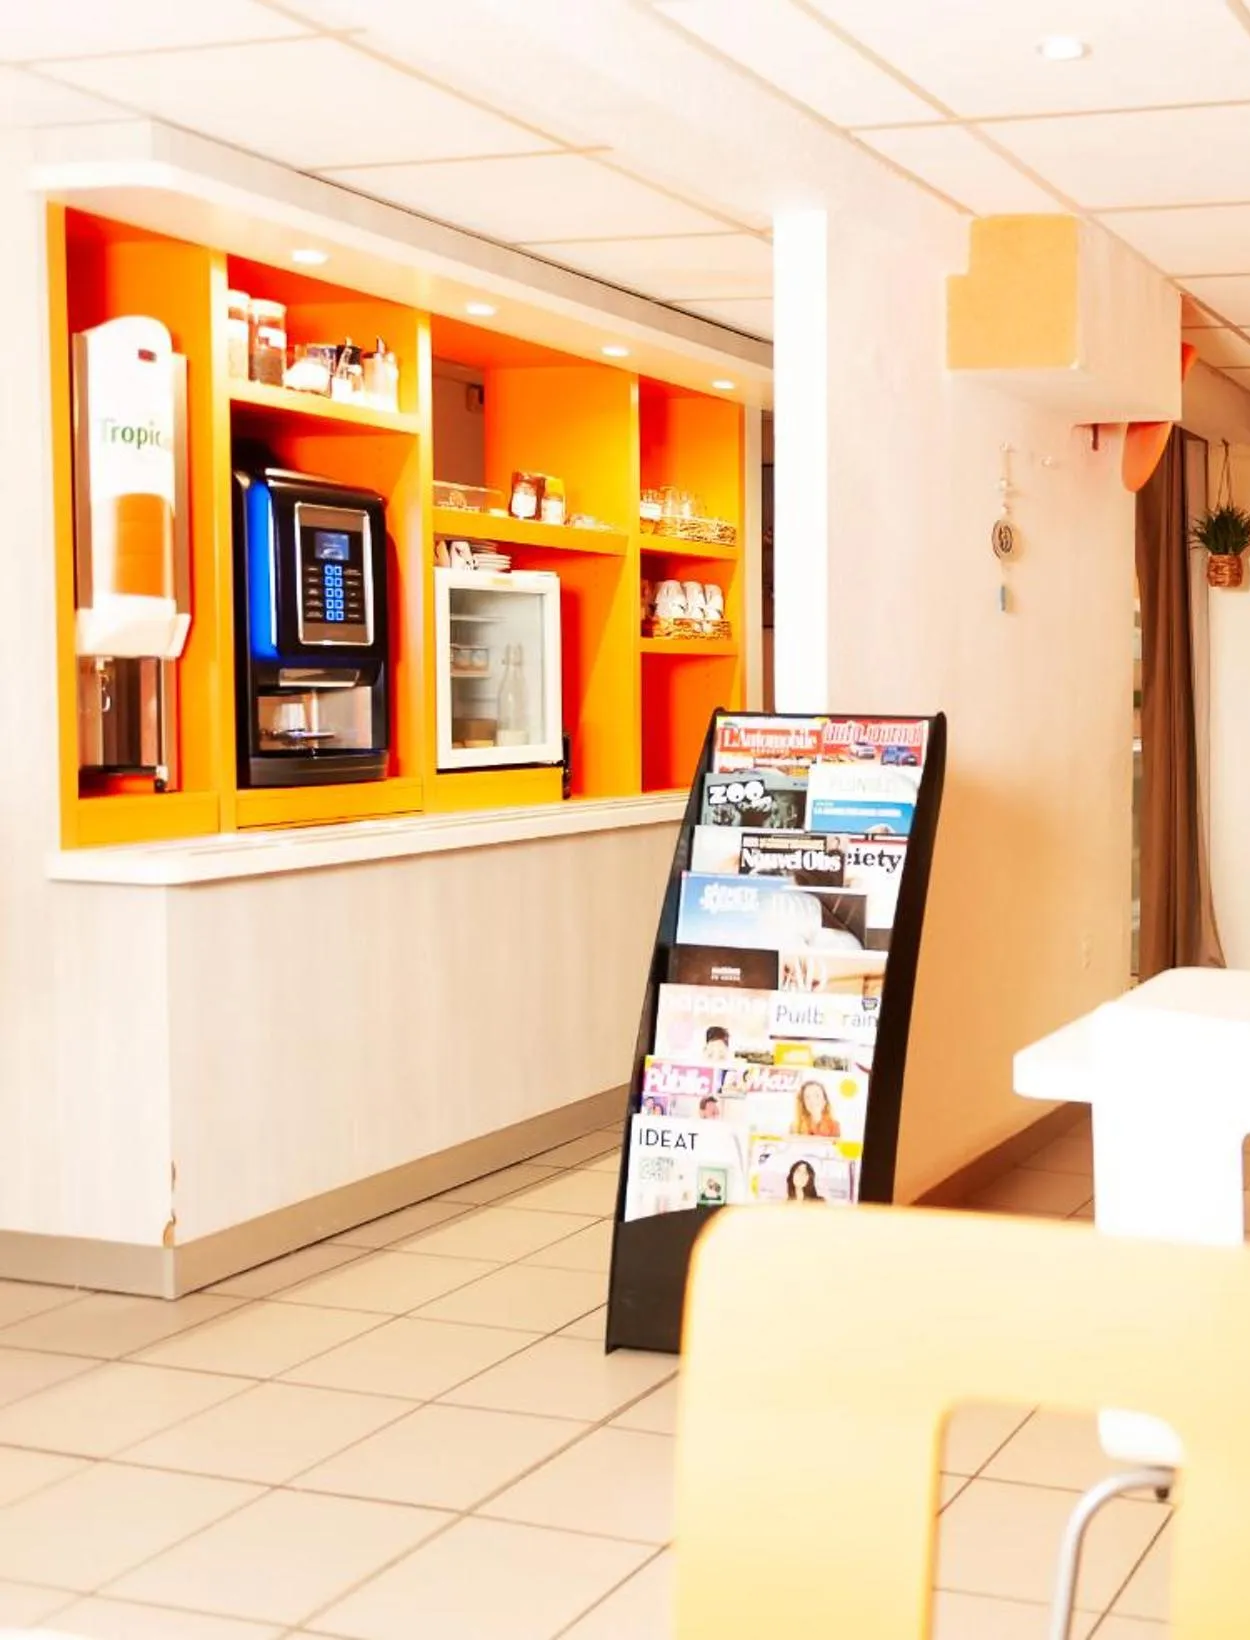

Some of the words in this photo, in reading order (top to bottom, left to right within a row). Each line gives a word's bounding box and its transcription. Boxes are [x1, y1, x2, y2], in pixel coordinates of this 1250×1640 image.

[803, 851, 841, 871] Obs
[645, 1063, 711, 1094] Public
[639, 1128, 699, 1151] IDEAT
